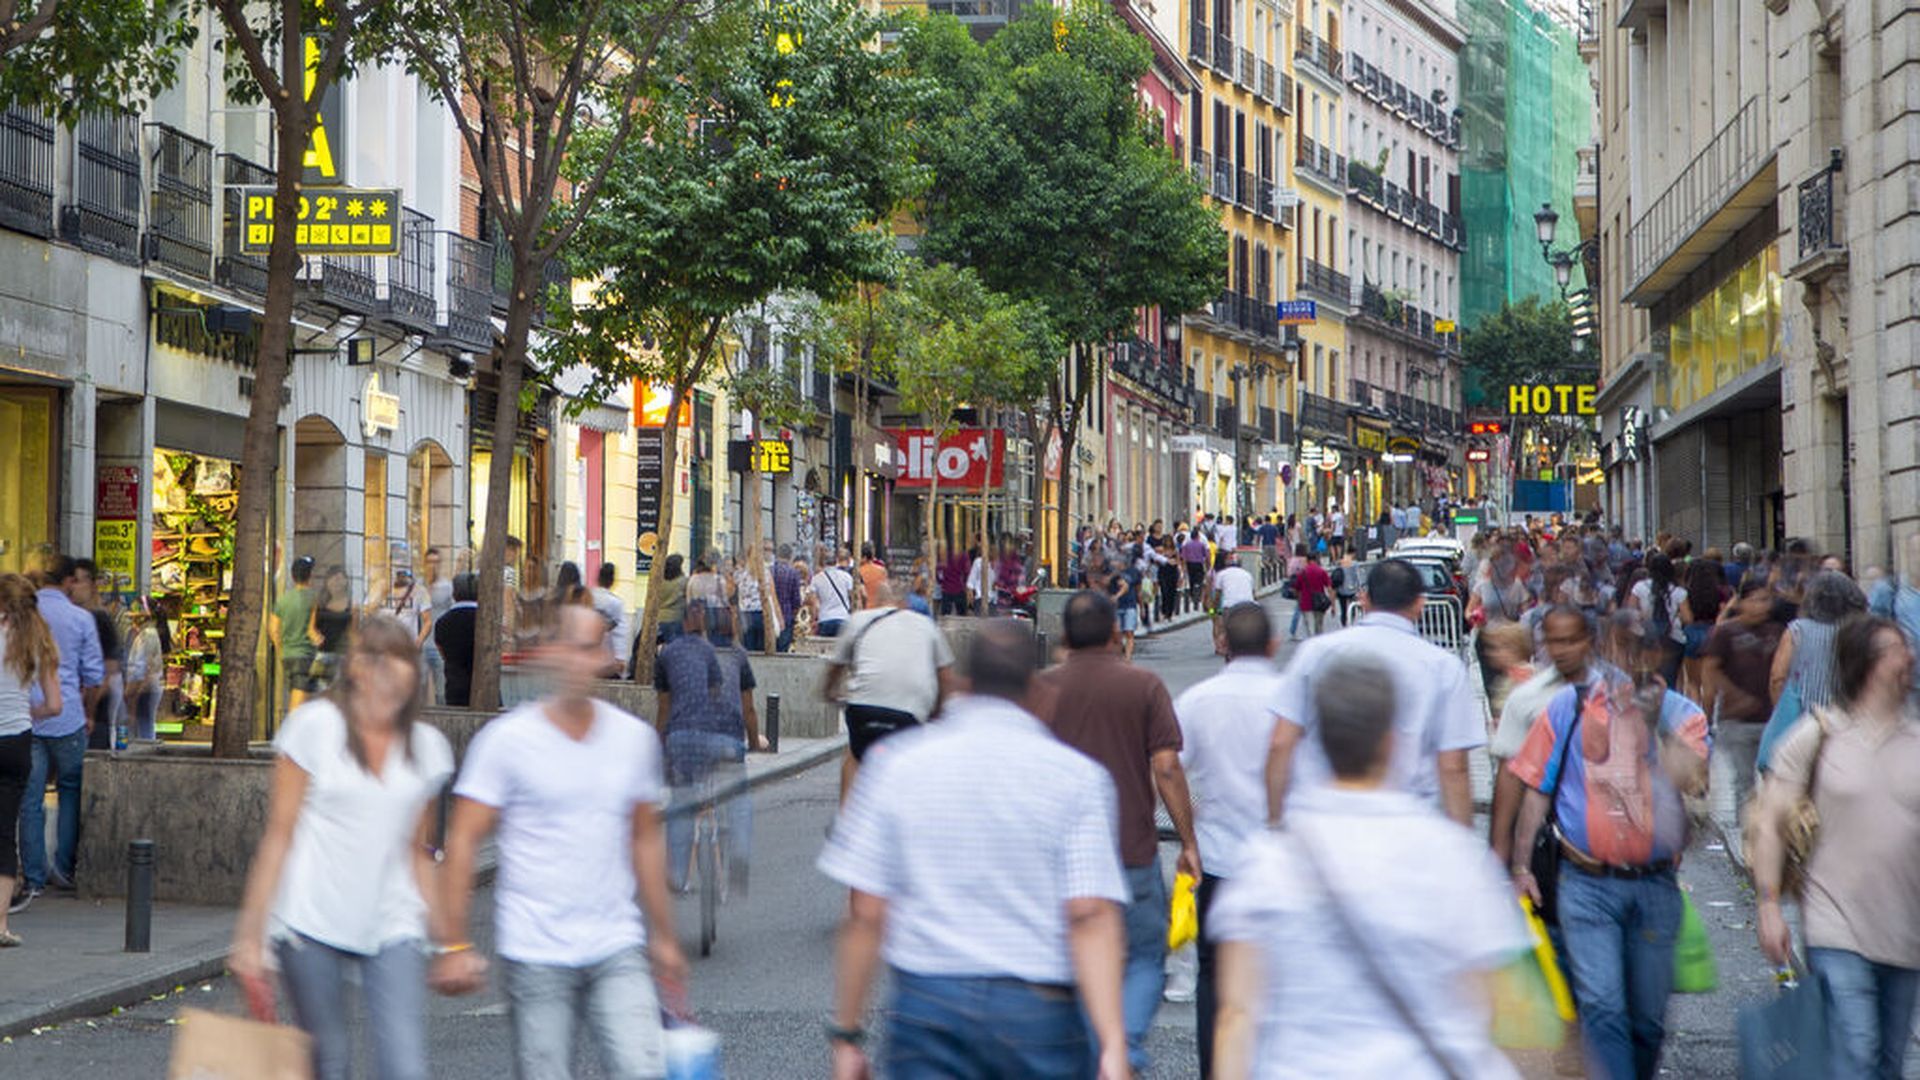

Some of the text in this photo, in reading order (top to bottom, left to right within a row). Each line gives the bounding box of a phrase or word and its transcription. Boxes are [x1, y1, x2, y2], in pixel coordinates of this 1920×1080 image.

[248, 196, 310, 220] PIO
[1509, 384, 1597, 415] HOTE
[1624, 405, 1637, 462] ZARA
